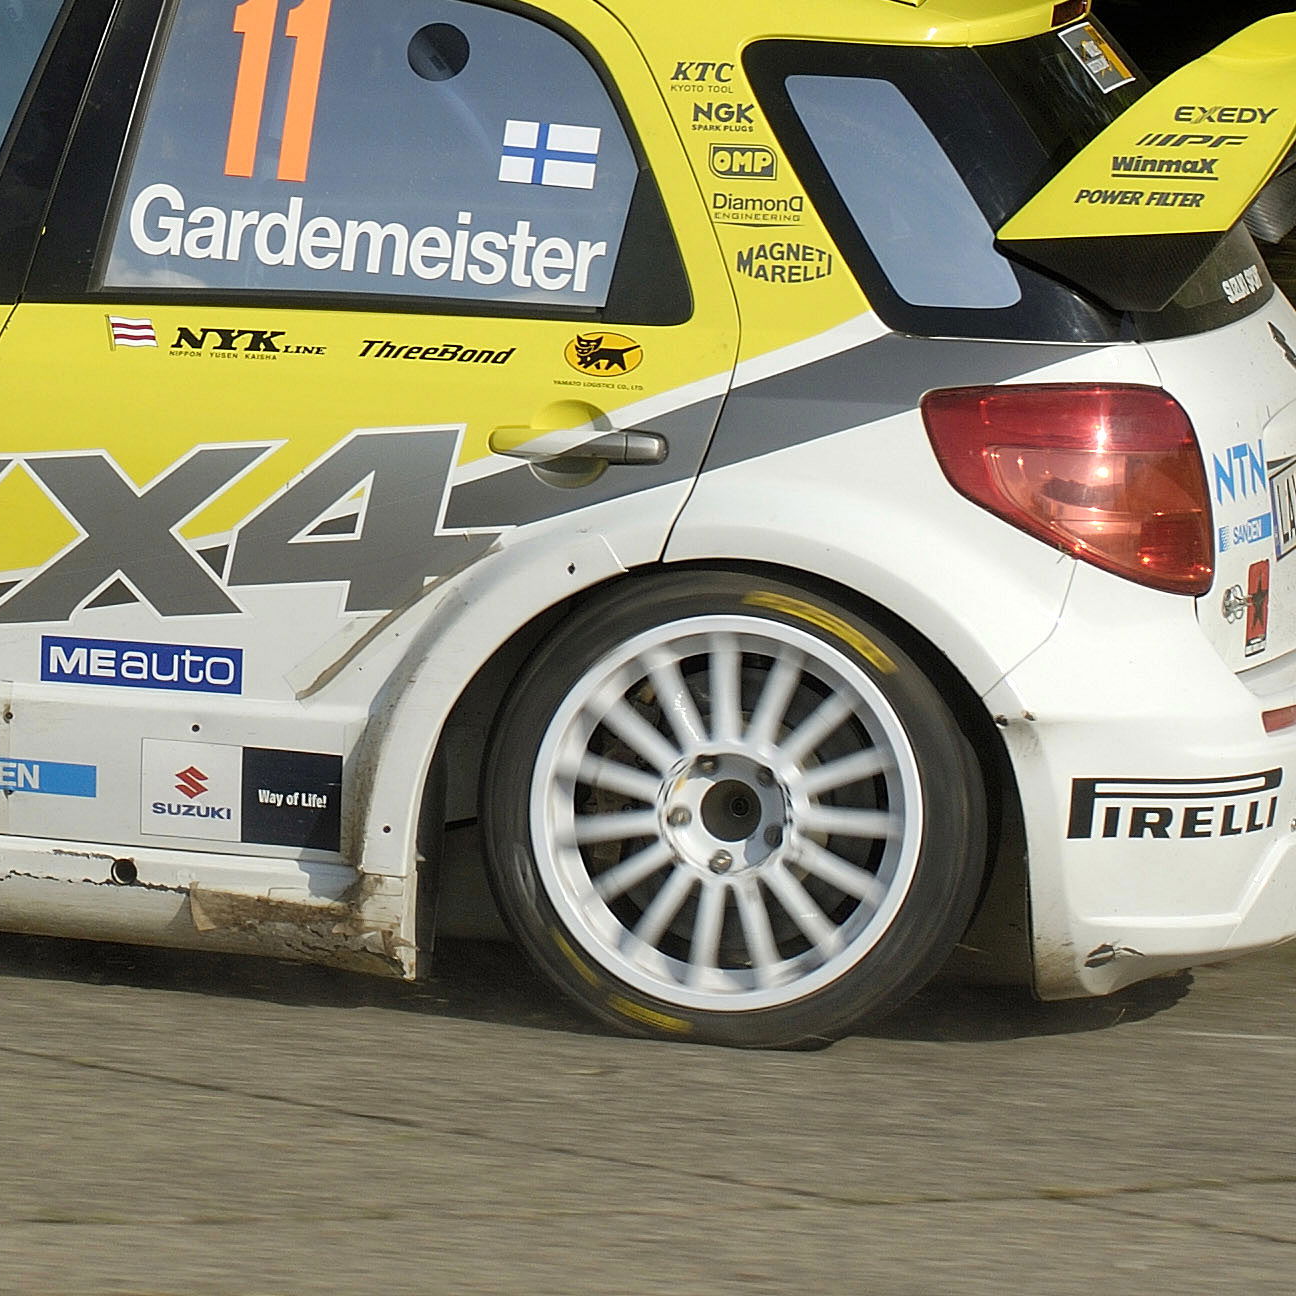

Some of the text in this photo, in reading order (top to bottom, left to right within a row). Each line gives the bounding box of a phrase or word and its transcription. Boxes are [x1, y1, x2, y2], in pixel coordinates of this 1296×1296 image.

[670, 61, 734, 83] KTC
[670, 84, 734, 94] KYOTO TOOL
[693, 102, 755, 124] NGK
[1174, 106, 1278, 124] EXEDY
[691, 124, 754, 133] SPARK PLUGS
[713, 150, 773, 174] OMP
[1074, 189, 1206, 208] POWER FILTER
[713, 212, 801, 222] ENGINEERING
[129, 183, 608, 293] Gardemeister
[736, 258, 833, 284] MARELLI
[170, 326, 328, 355] NYK LINE
[169, 350, 202, 358] NIPPON
[209, 352, 239, 360] YUSEN
[358, 340, 517, 365] ThreeBond
[1212, 438, 1267, 505] NTN
[258, 788, 328, 809] Way of Life!
[1066, 767, 1284, 840] PIRELLI
[151, 801, 232, 821] SUZUKI
